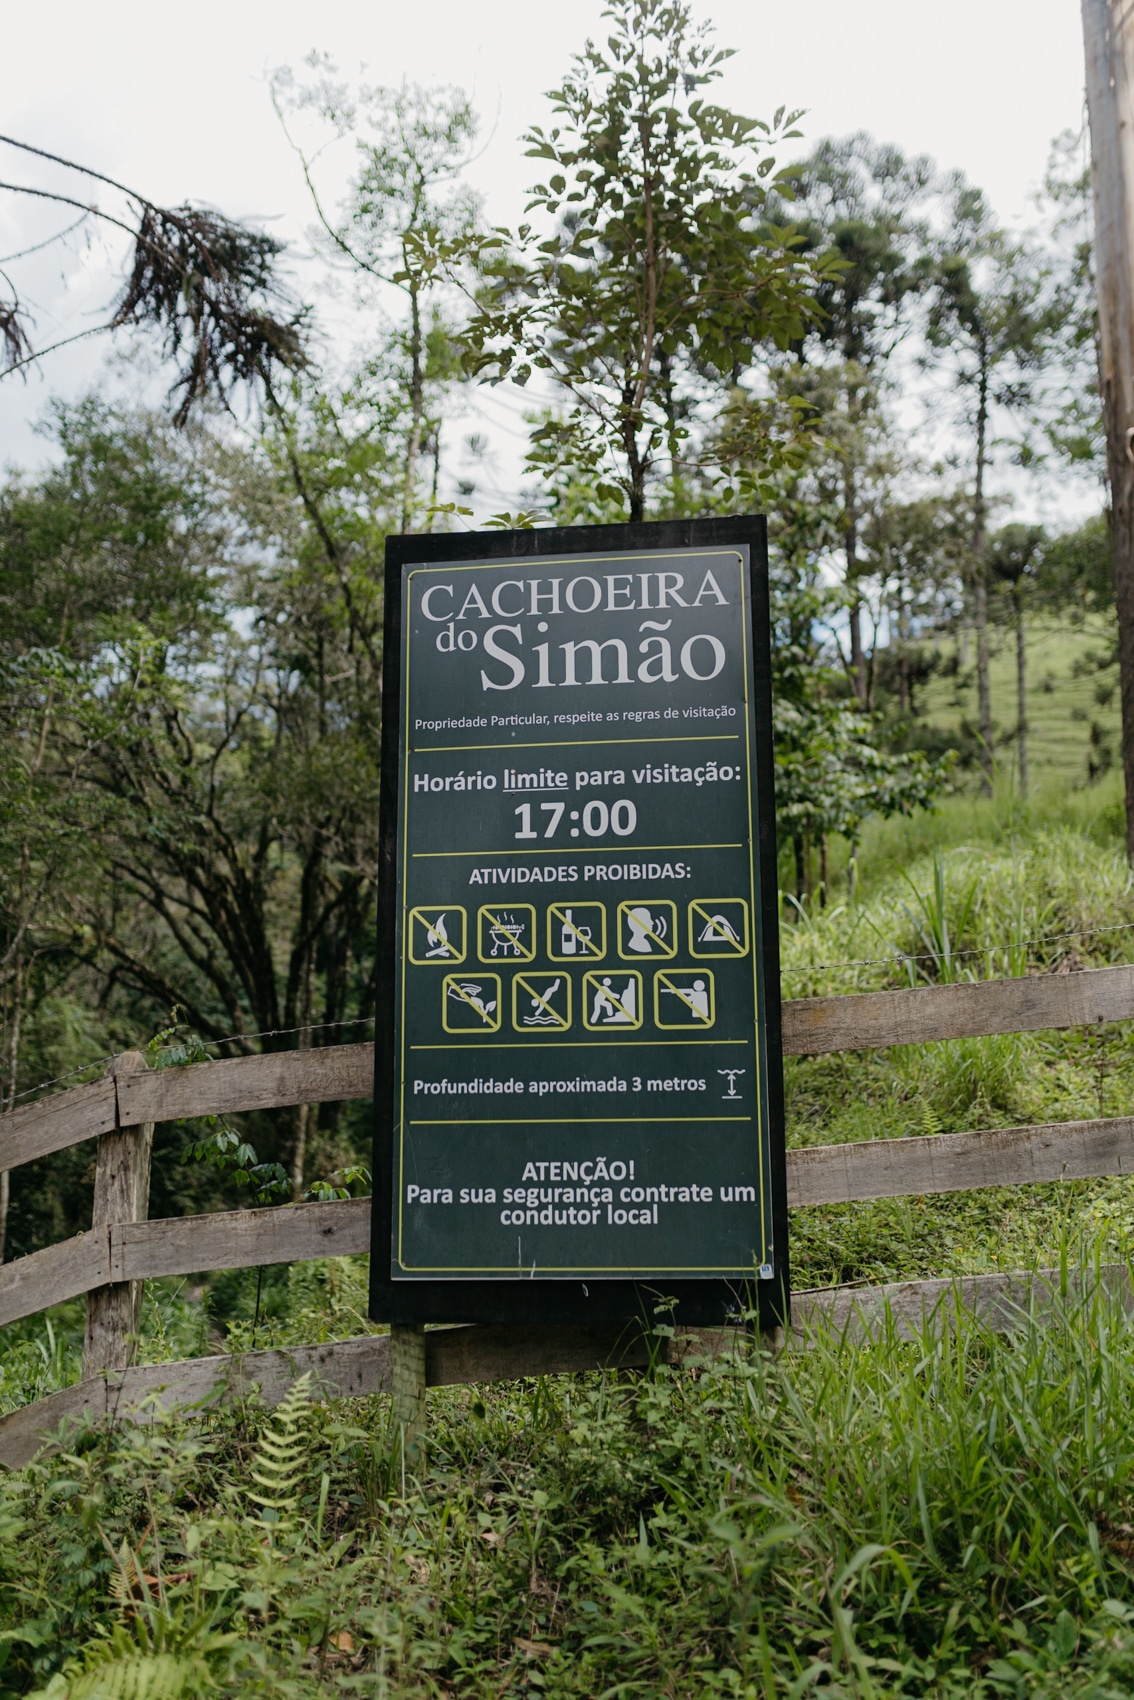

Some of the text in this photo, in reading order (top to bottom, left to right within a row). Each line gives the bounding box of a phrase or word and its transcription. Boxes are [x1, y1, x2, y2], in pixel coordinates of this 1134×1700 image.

[421, 569, 730, 622] CACHOEIRA
[436, 619, 726, 691] do Simão
[415, 705, 736, 730] Propriedade Particular, respeite as regras de visitação
[413, 762, 741, 793] Horário limite para visitação:
[514, 799, 637, 839] 17:00
[469, 863, 691, 885] ATIVIDADES PROIBIDAS:
[413, 1077, 706, 1096] Profundidade aproximada 3 metros
[522, 1157, 636, 1185] ATENÇÃO!
[407, 1184, 756, 1207] Para sua segurança contrate um
[500, 1205, 658, 1225] condutor local
